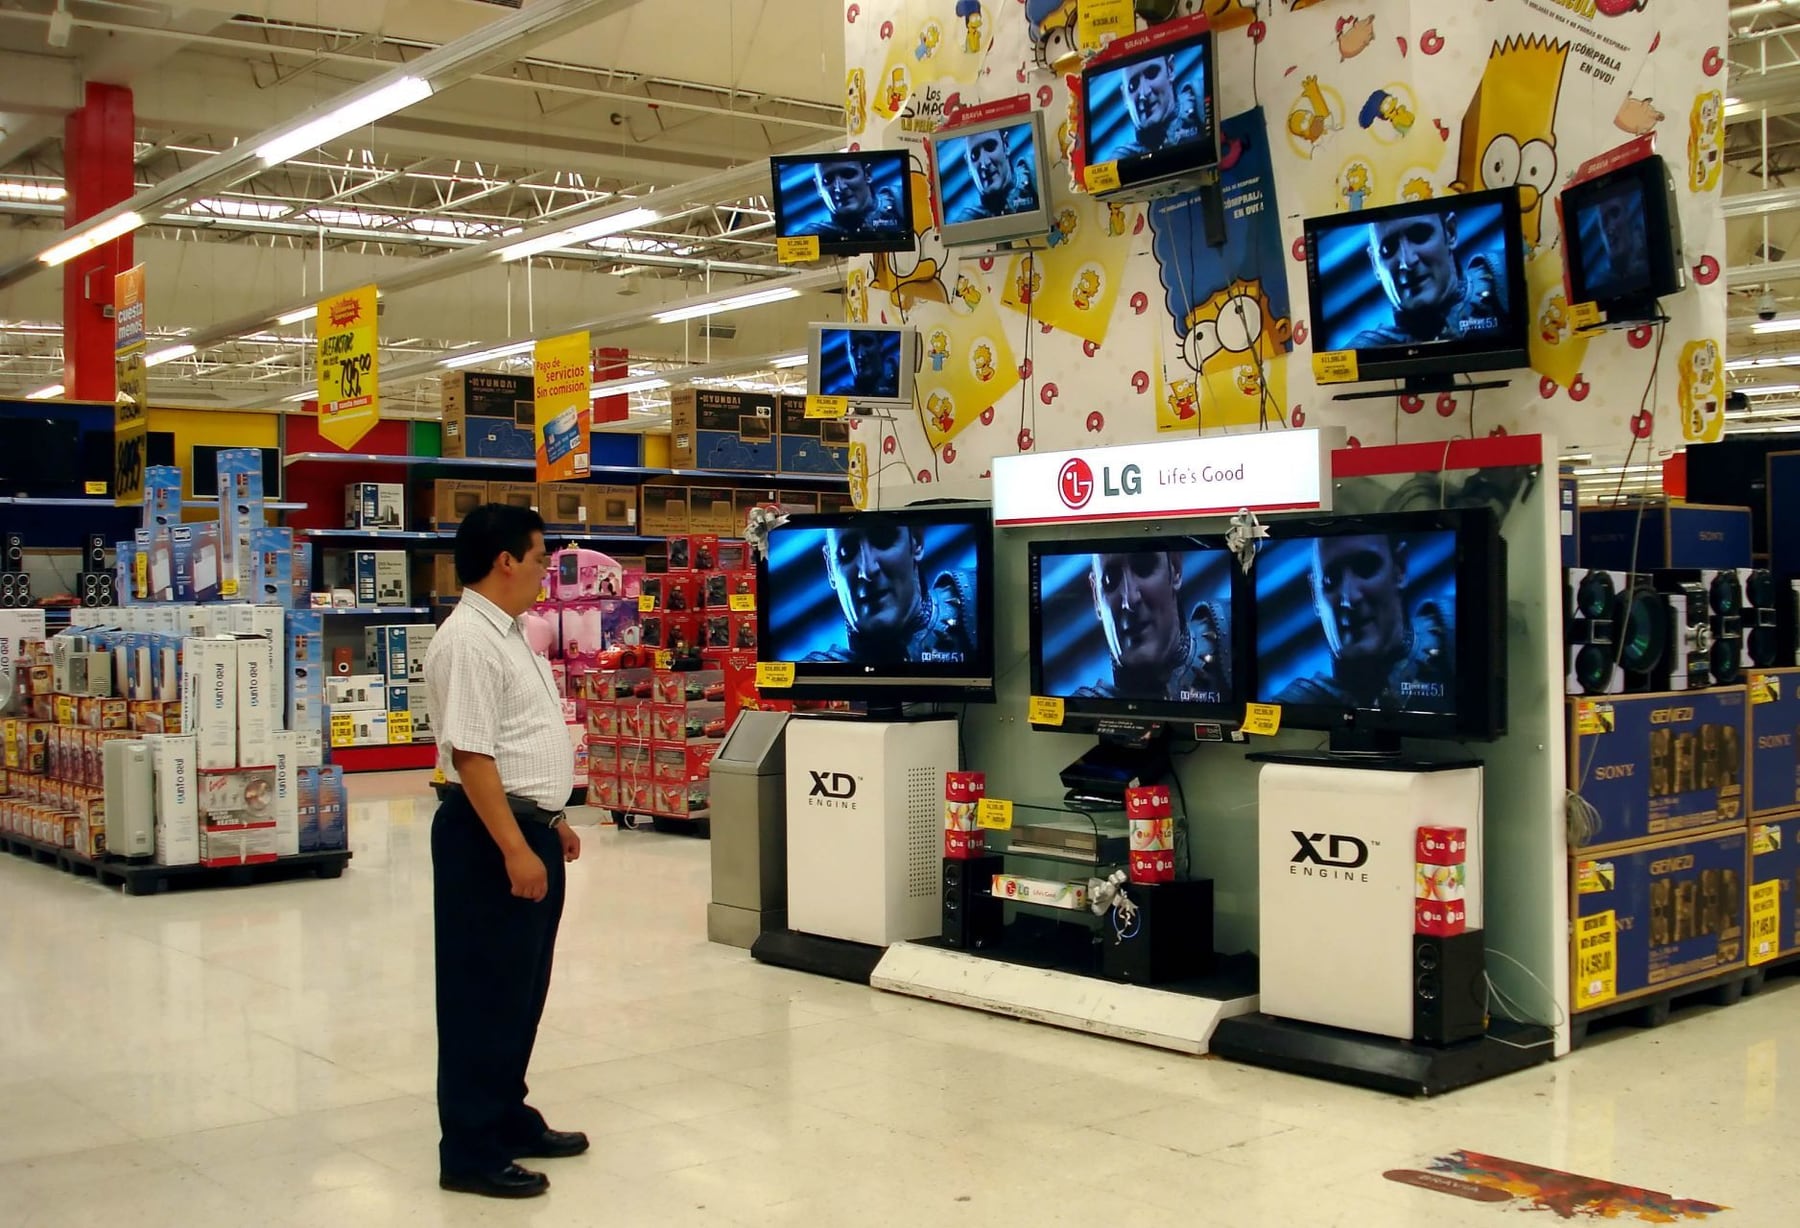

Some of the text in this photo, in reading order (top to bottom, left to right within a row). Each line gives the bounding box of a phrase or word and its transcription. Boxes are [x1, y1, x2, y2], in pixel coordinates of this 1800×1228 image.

[1571, 42, 1622, 72] ¡CÓMPRALA
[1580, 62, 1615, 85] EN DVD!
[536, 357, 560, 373] Pago de
[546, 364, 584, 382] servicios
[472, 378, 517, 389] HYUNDAI
[536, 380, 587, 399] Sin comisión.
[703, 394, 741, 405] HYUNDAI
[1103, 464, 1244, 497] LG Life's Good
[1759, 735, 1791, 749] SONY
[1595, 764, 1635, 780] SONY
[808, 798, 857, 810] ENGINE
[1290, 866, 1369, 883] ENGINE
[1018, 883, 1029, 896] LG
[1616, 917, 1635, 932] NY
